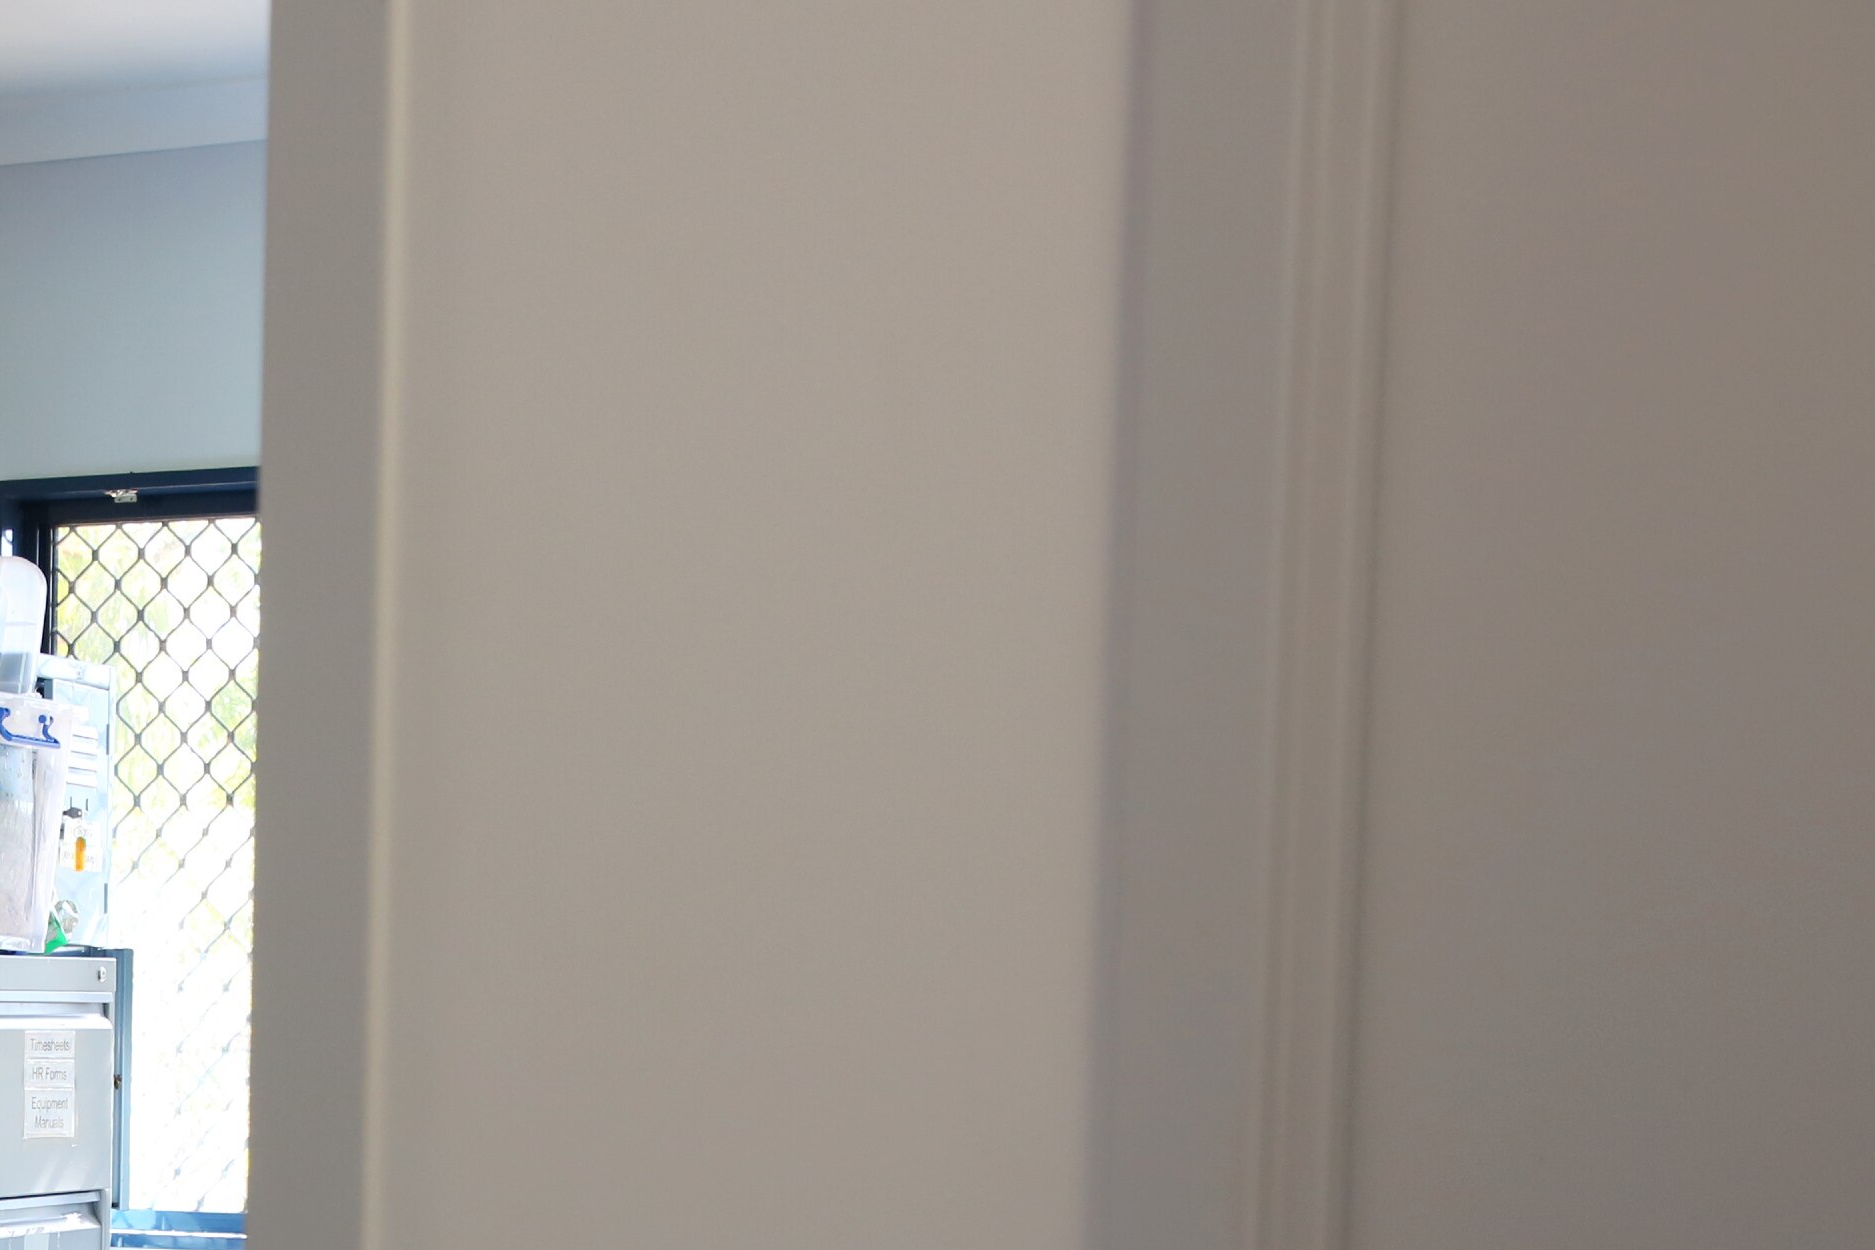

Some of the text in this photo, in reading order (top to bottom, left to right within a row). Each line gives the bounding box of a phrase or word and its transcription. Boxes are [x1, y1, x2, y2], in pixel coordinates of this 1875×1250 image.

[30, 1038, 70, 1052] Timesheets
[32, 1066, 67, 1080] HR Forms
[31, 1096, 68, 1112] Equipment
[34, 1115, 65, 1129] Manuals
